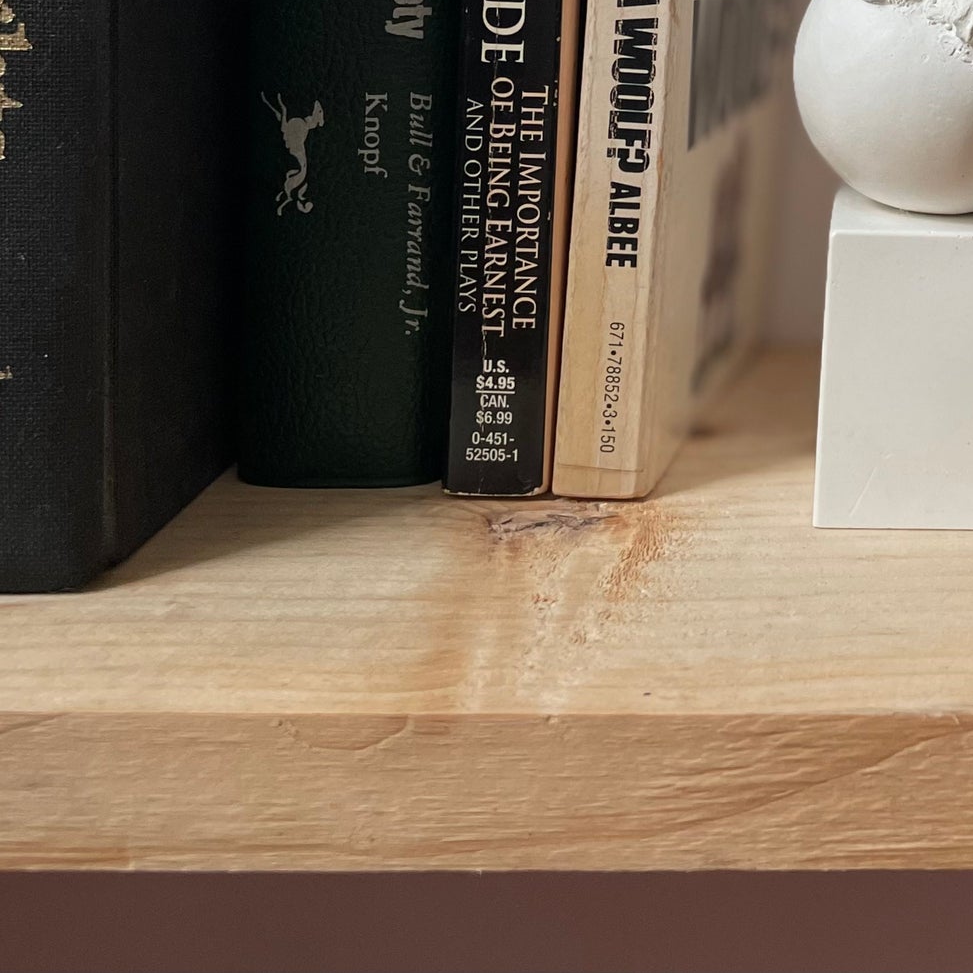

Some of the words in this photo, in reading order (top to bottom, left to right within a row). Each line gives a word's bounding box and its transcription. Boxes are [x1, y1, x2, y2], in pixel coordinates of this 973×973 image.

[409, 91, 433, 147] Bull
[491, 77, 515, 113] OF
[517, 85, 549, 142] THE
[606, 17, 659, 173] WOOLF?
[357, 92, 388, 179] Knopf
[465, 98, 484, 152] AND
[408, 153, 431, 176] &
[486, 122, 517, 208] BEING
[461, 159, 482, 242] OTHER
[605, 181, 641, 268] ALBEE
[402, 184, 431, 296] Farrand,
[512, 151, 547, 329] IMPORTANCE
[458, 250, 479, 313] PLAYS
[481, 218, 513, 337] EARNEST
[399, 299, 429, 336] Jr.
[476, 375, 515, 390] $4.95
[483, 360, 509, 373] U.S.
[476, 411, 513, 425] $6.99
[480, 394, 510, 408] CAN.
[465, 449, 519, 462] 52505-1
[471, 432, 515, 445] 0-451-
